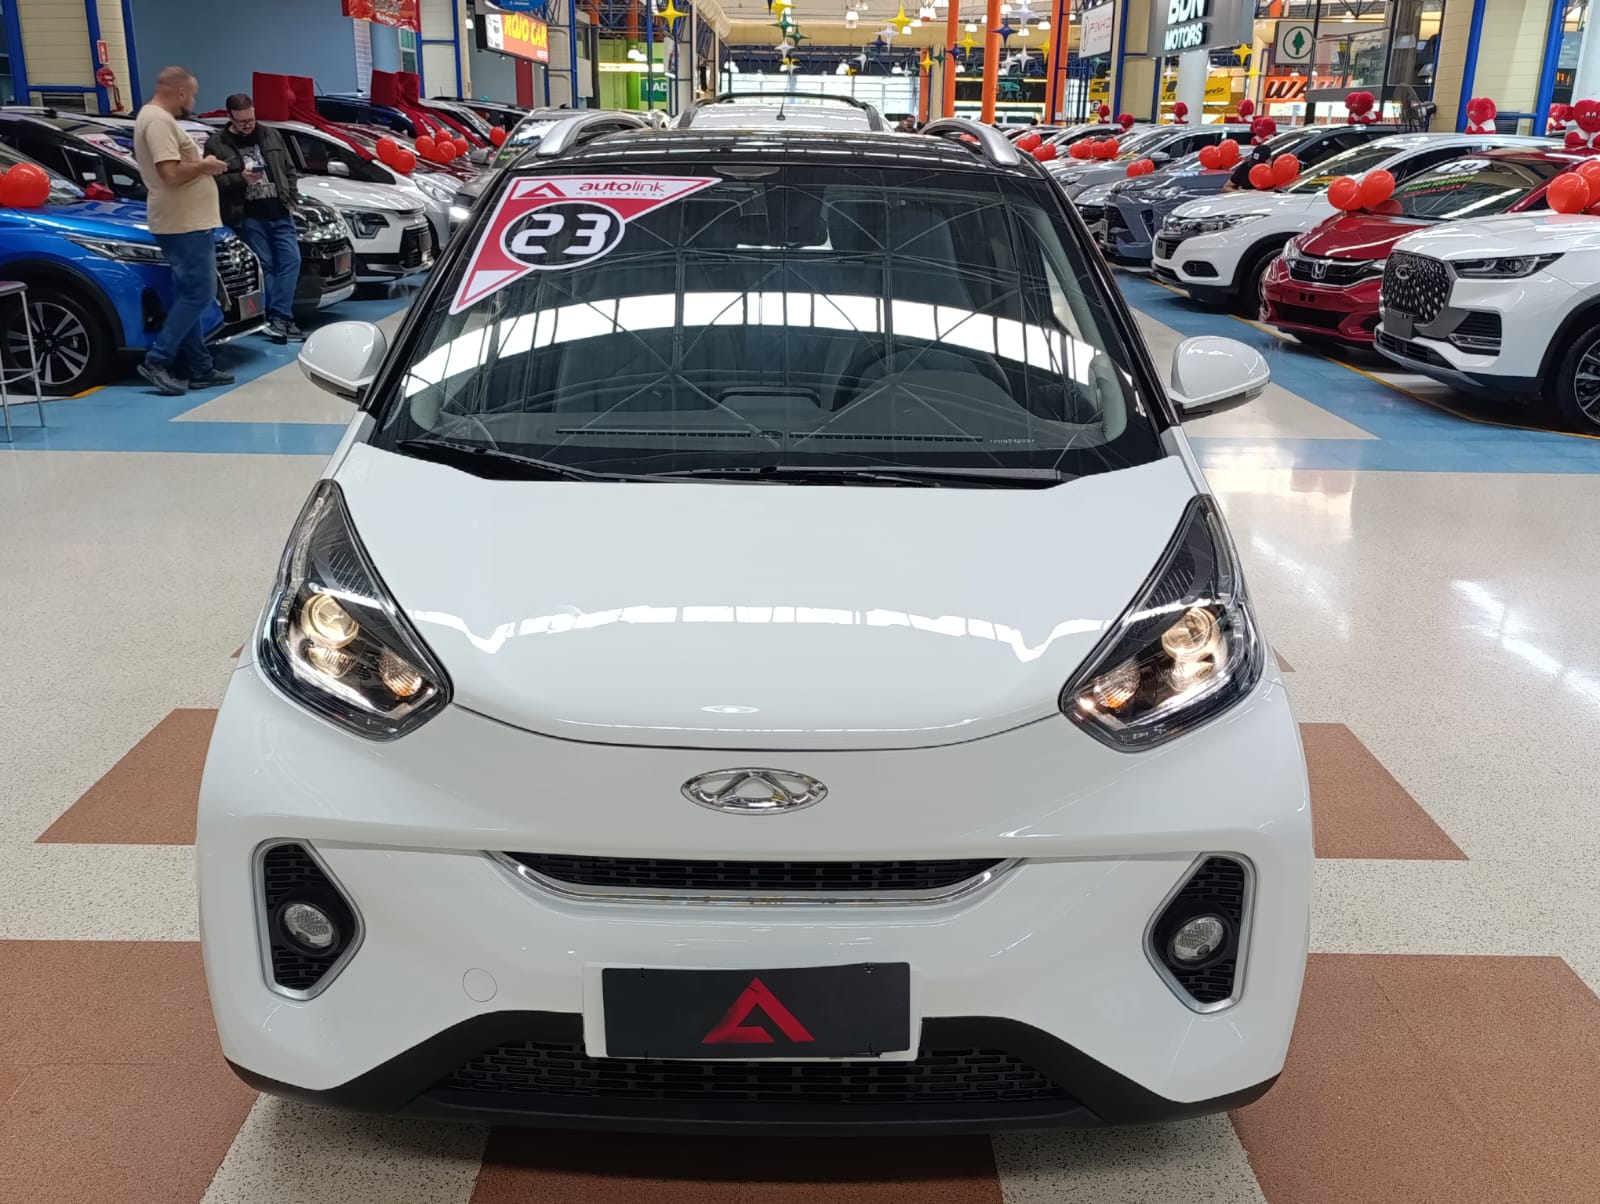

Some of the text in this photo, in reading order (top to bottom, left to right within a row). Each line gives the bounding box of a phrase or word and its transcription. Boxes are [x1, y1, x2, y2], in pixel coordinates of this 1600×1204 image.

[531, 22, 547, 48] CAR
[1164, 22, 1203, 51] MOTORS
[579, 181, 665, 192] autolink
[511, 213, 611, 255] 23
